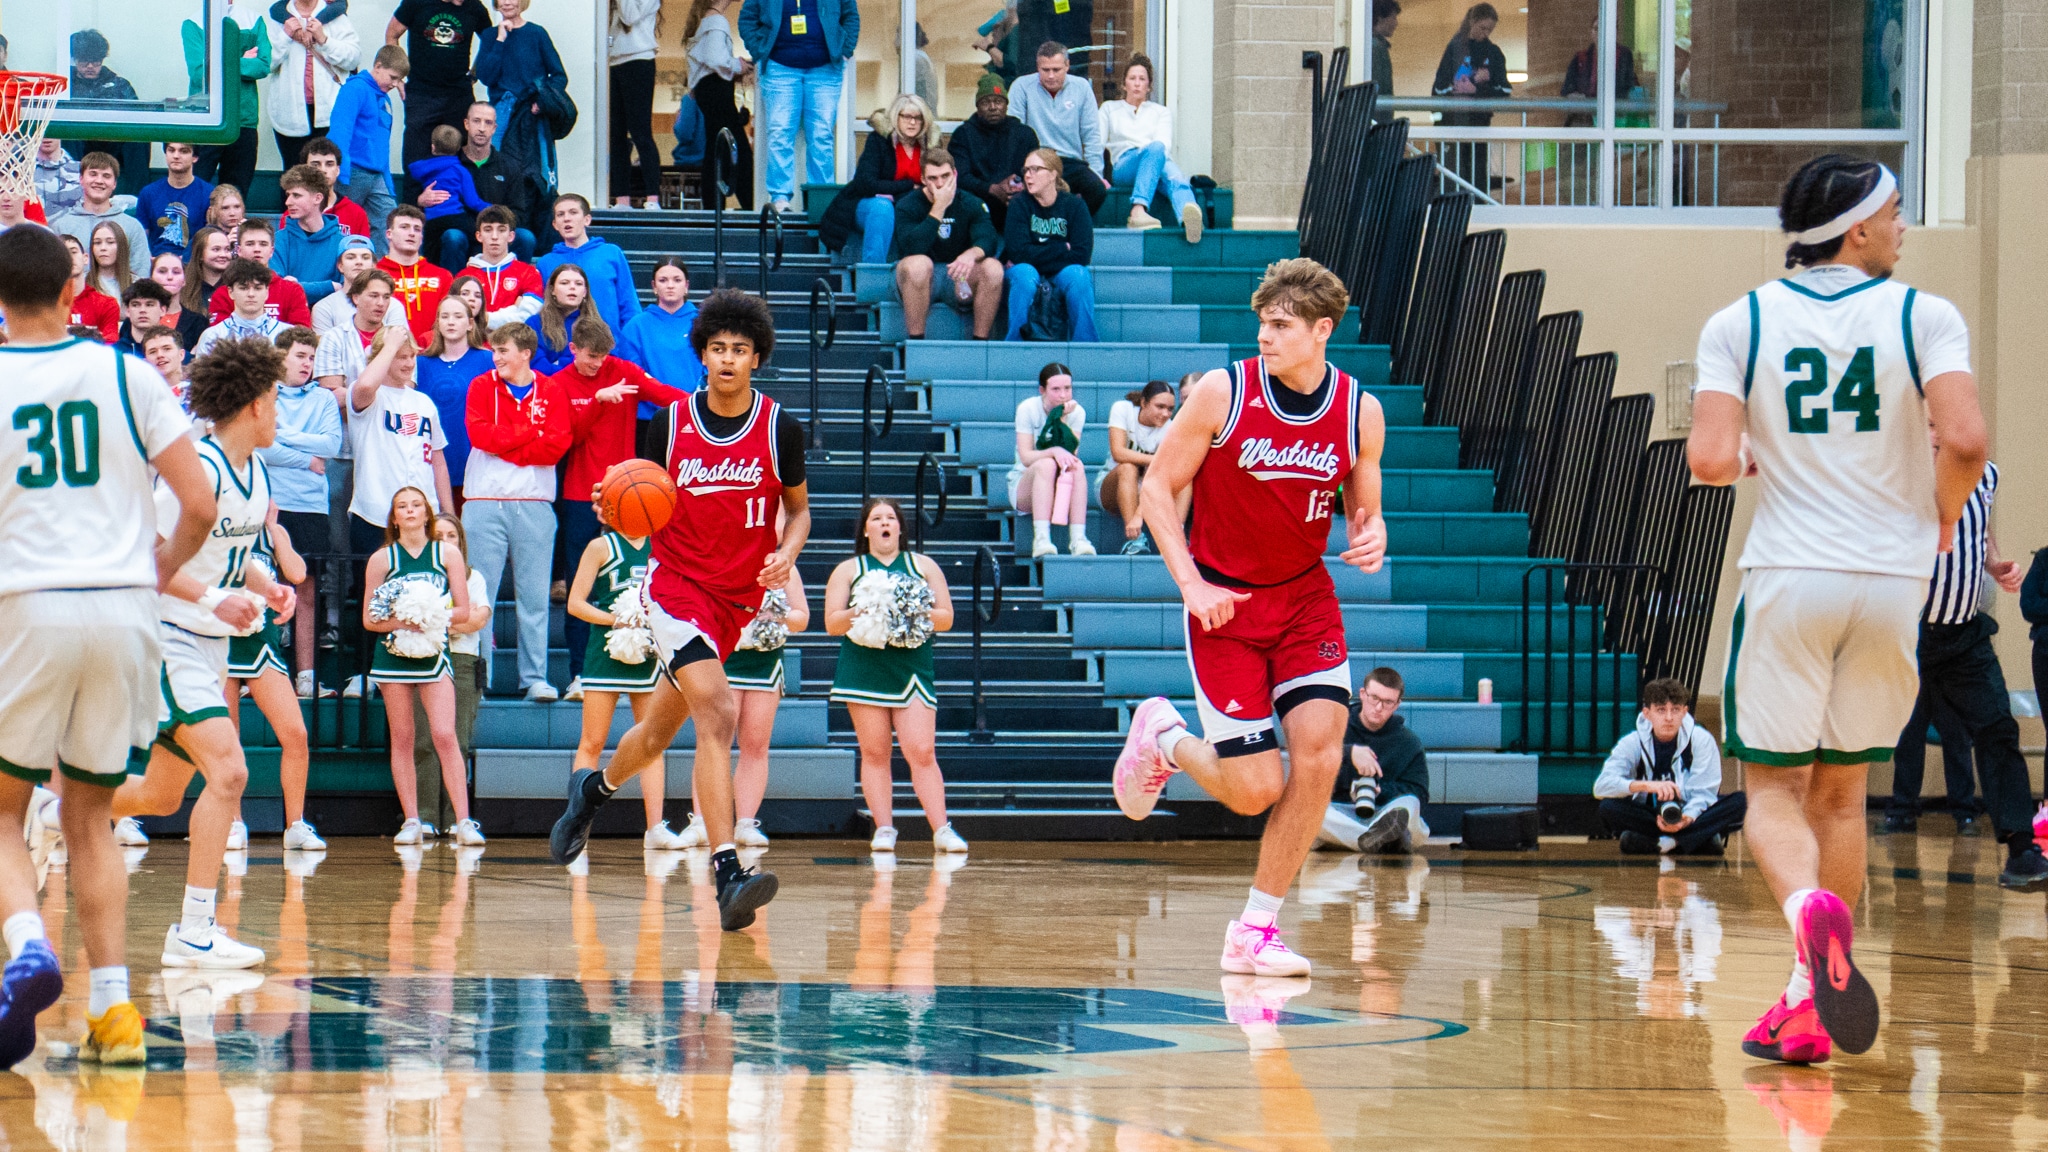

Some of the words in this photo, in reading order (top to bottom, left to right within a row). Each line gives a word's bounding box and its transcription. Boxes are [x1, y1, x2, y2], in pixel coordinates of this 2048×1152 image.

[394, 277, 440, 289] HEFS
[1784, 346, 1880, 434] 24
[384, 410, 432, 440] USA
[12, 399, 100, 488] 30
[1238, 438, 1340, 476] Westside
[676, 457, 764, 487] Westside
[744, 496, 766, 529] 11
[1305, 489, 1335, 522] 12
[609, 565, 649, 592] LS
